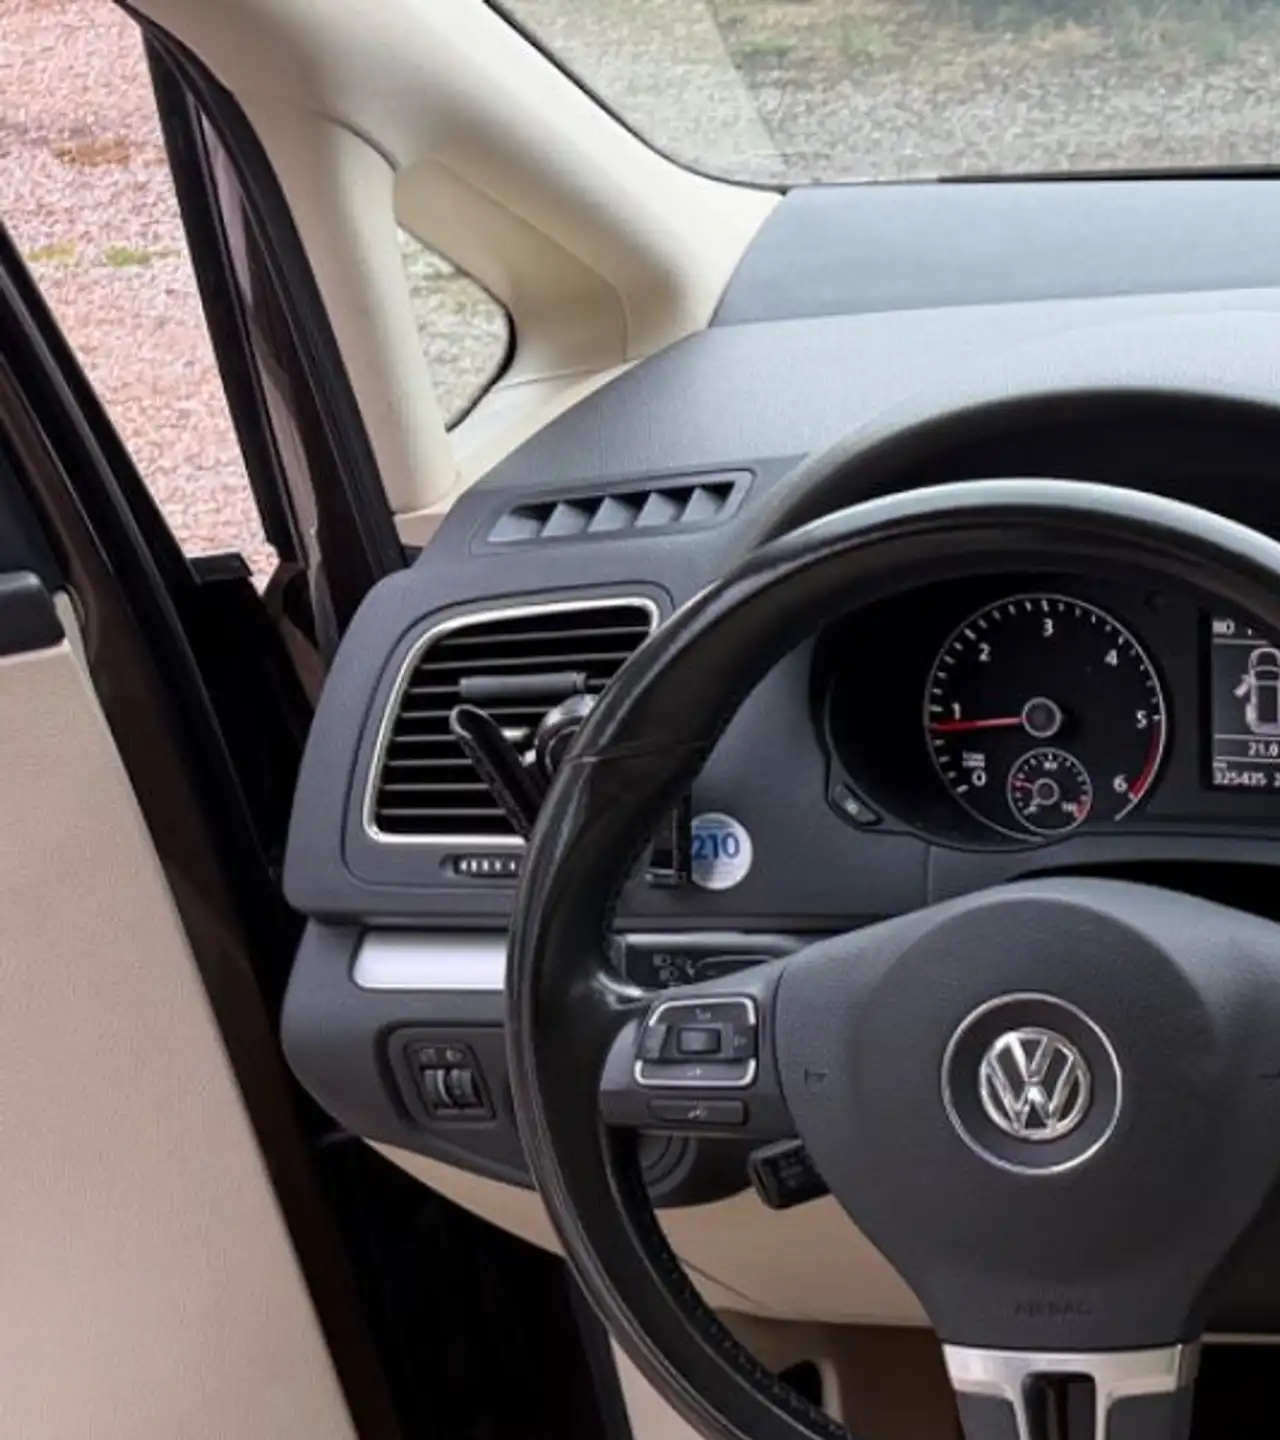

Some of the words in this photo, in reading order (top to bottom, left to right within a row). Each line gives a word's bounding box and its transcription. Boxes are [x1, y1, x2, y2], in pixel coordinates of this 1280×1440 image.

[1043, 618, 1054, 638] 3
[979, 643, 992, 662] 2
[1104, 650, 1119, 667] 4
[952, 702, 962, 721] 1
[1136, 710, 1148, 729] 5
[972, 768, 987, 787] 0
[1112, 773, 1128, 793] 6
